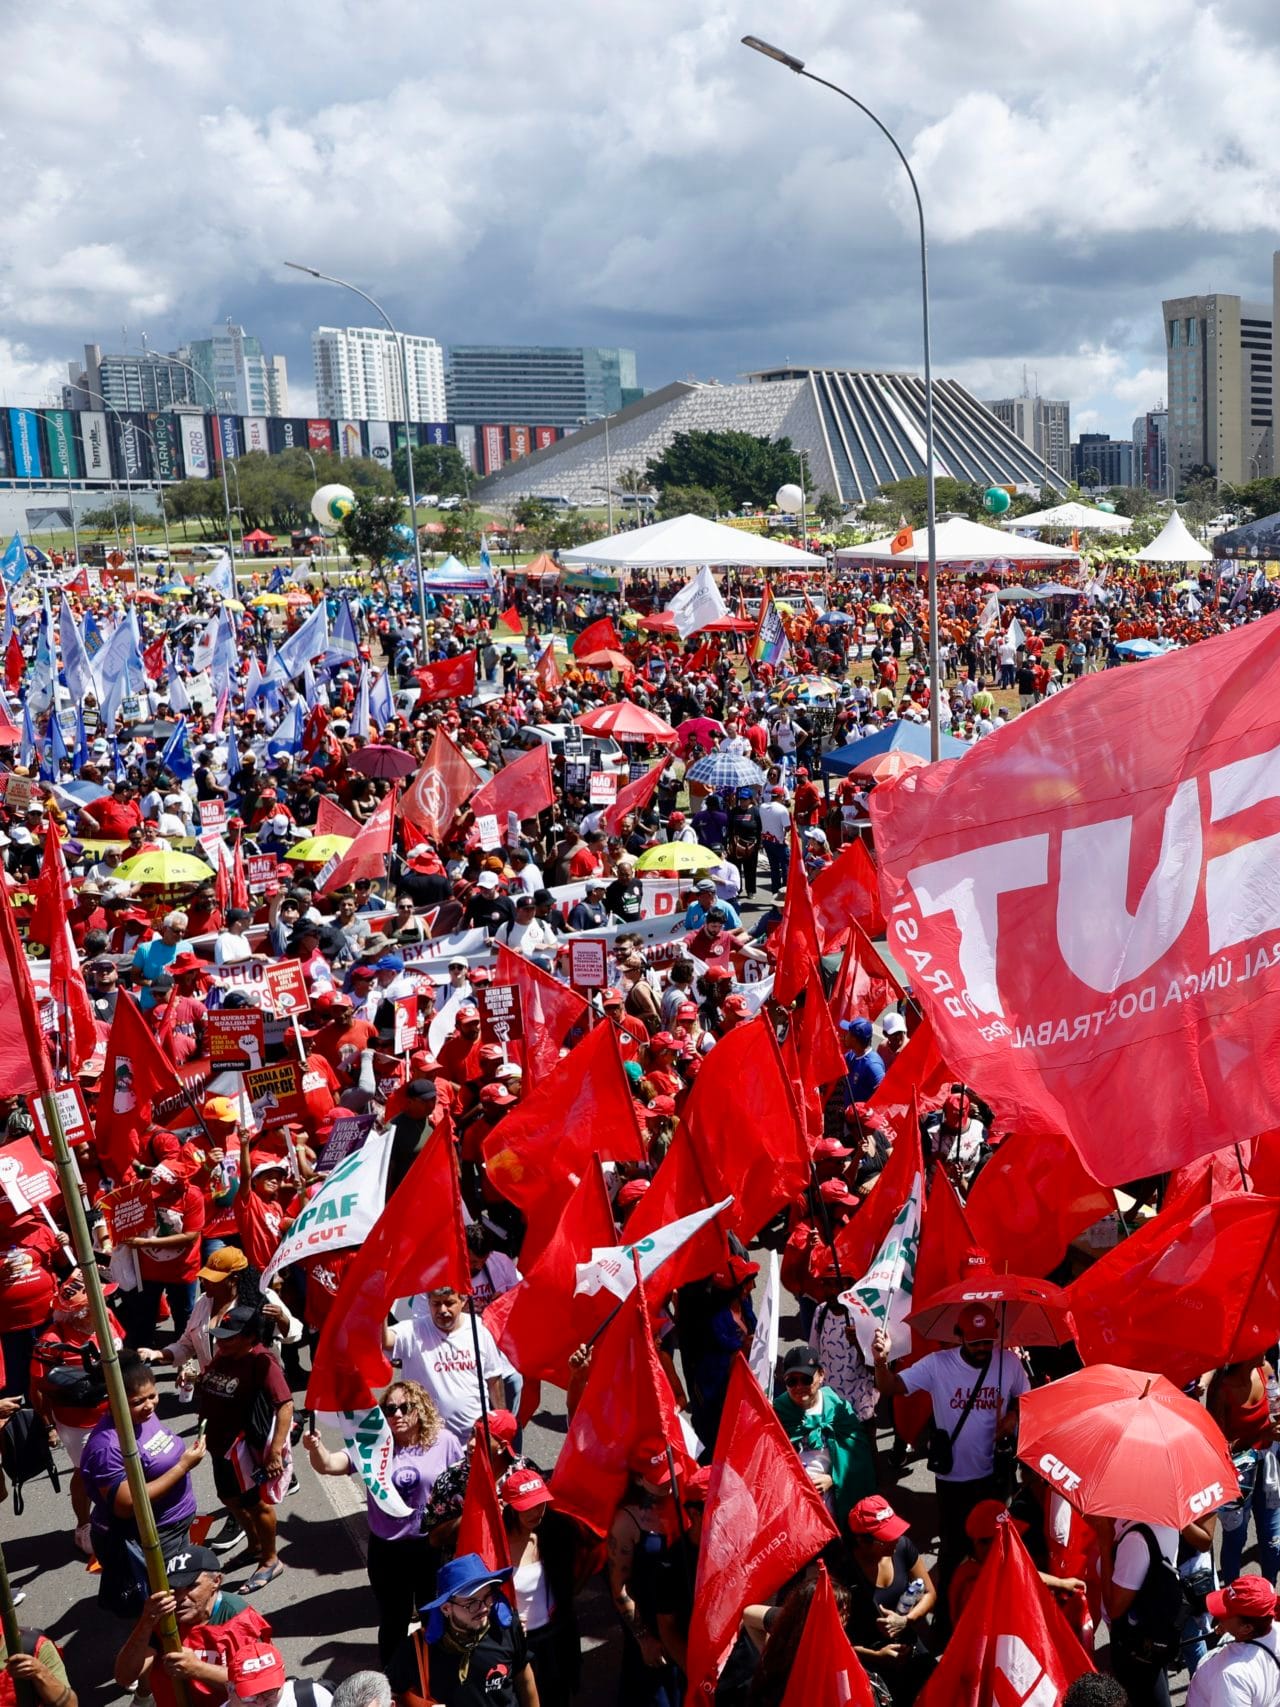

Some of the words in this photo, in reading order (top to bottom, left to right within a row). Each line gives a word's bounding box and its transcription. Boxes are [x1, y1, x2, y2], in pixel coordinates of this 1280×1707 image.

[219, 964, 263, 986] PELO
[250, 1071, 279, 1086] ESCALA
[308, 1225, 347, 1244] CUT
[962, 1291, 1003, 1300] CUT
[434, 1361, 476, 1373] CONTINU
[1039, 1453, 1081, 1491] CUT
[1189, 1482, 1223, 1513] CUT
[167, 1553, 192, 1574] NY
